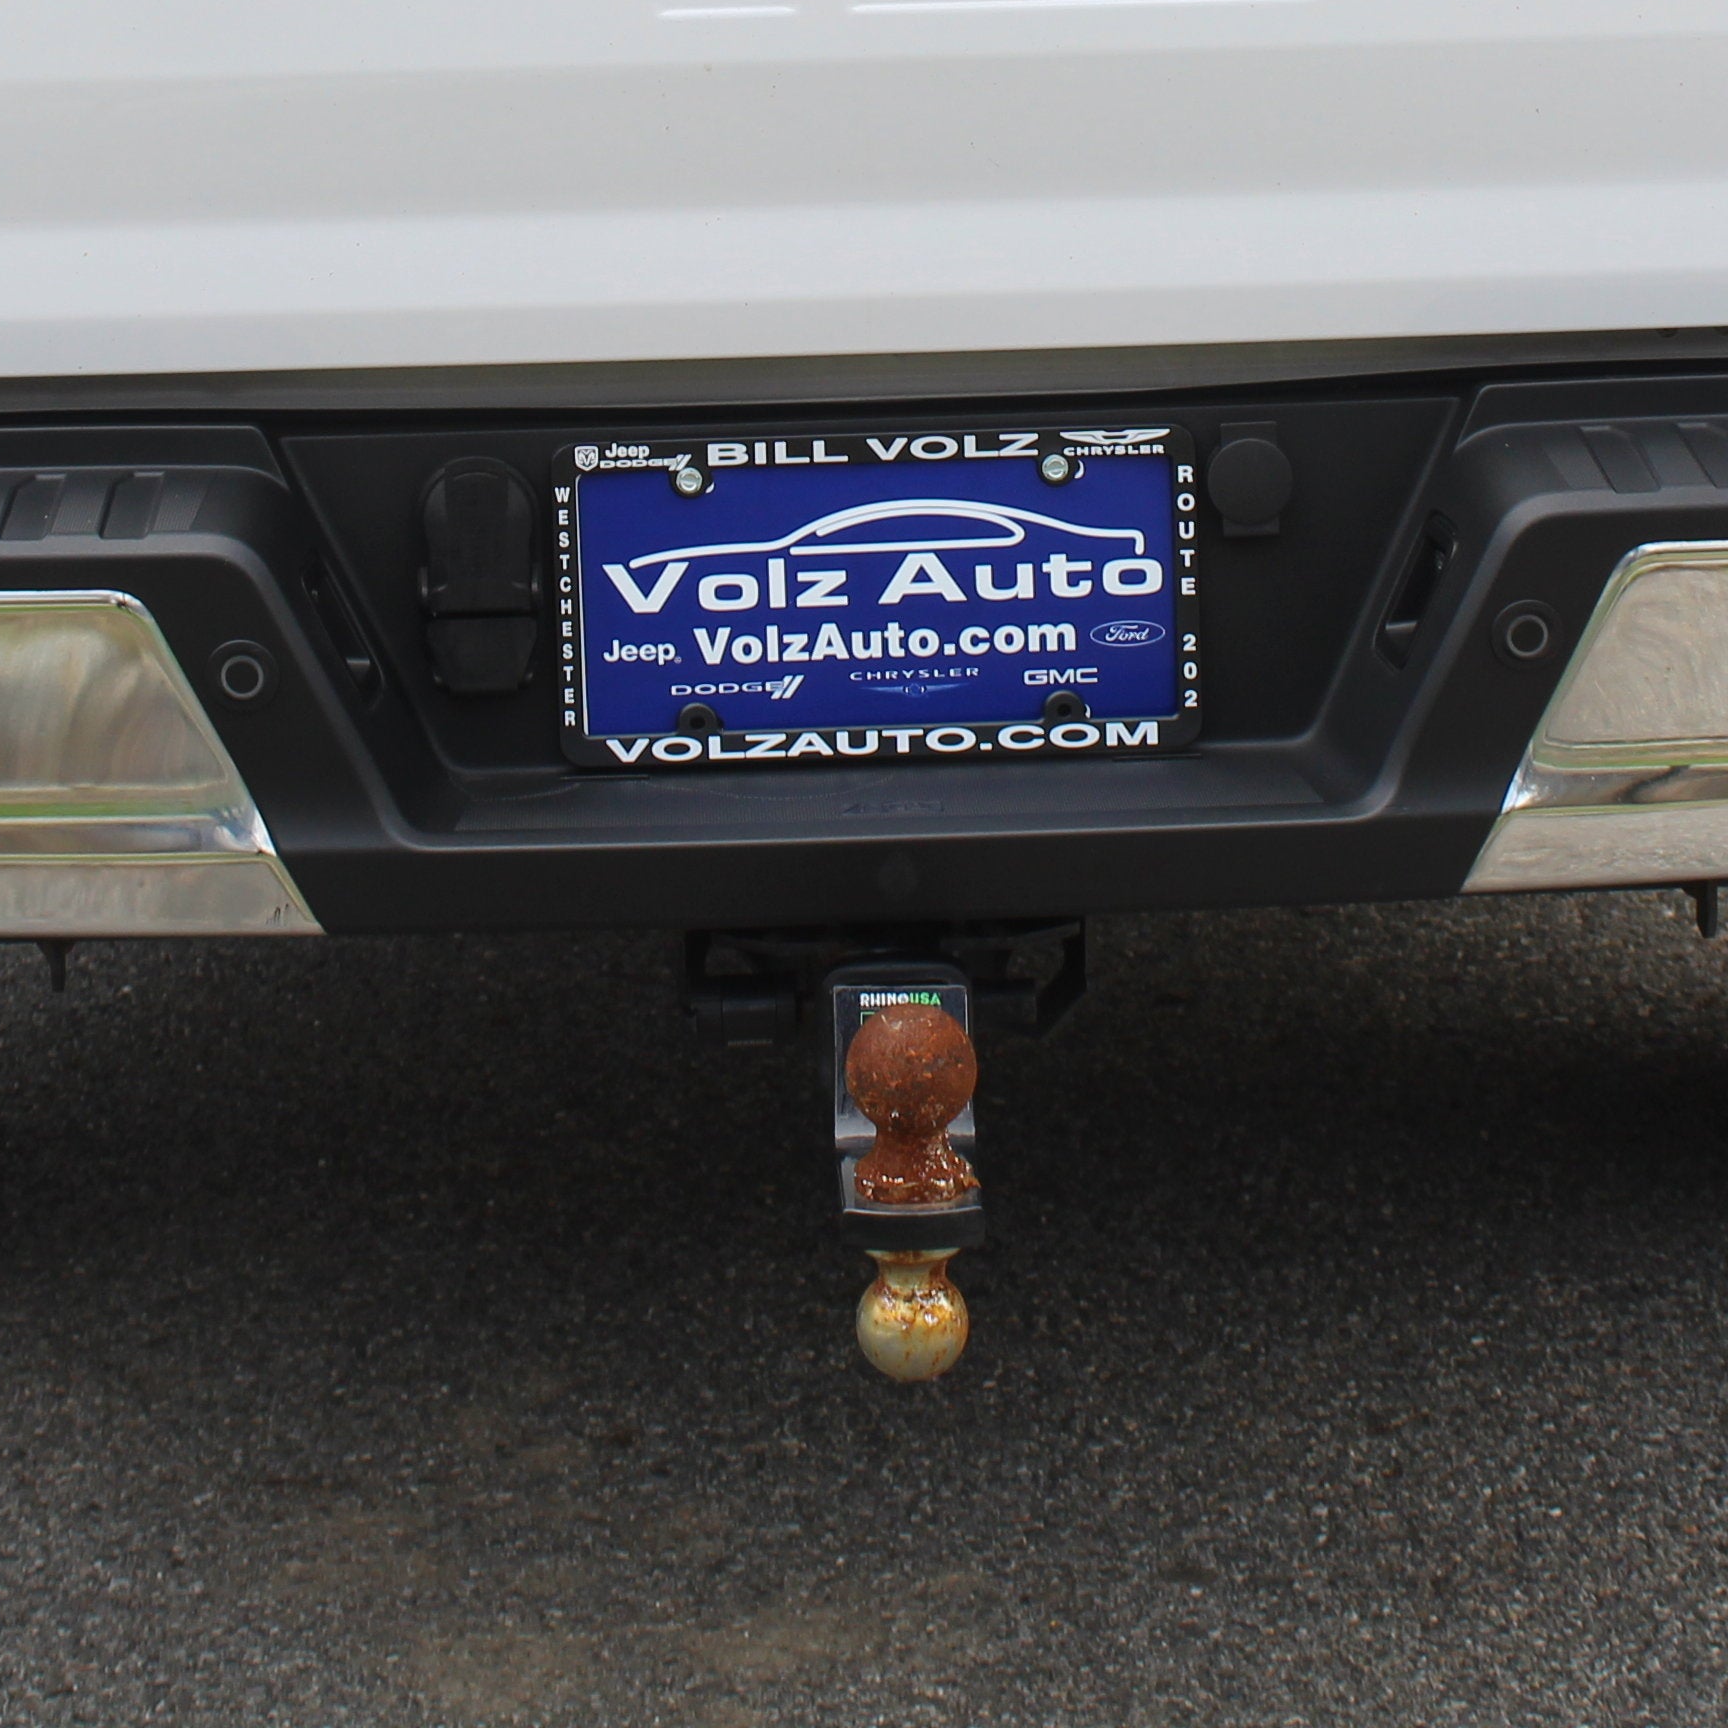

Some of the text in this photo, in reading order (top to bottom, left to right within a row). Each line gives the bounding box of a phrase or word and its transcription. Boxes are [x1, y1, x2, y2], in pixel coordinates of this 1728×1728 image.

[604, 442, 650, 460] Jeep
[706, 432, 1039, 467] BILL VOLZ
[1063, 444, 1165, 457] CHRYSLER
[599, 457, 678, 469] DODGE
[601, 552, 1164, 614] Volz Auto
[1176, 464, 1199, 708] ROUTE 202
[554, 486, 576, 728] WESTCHESTER
[692, 621, 1077, 666] VolzAuto.com
[1104, 624, 1150, 642] Ford
[603, 639, 677, 666] Jeep
[849, 667, 980, 681] CHRYSLER
[1023, 667, 1099, 686] GMC
[670, 679, 788, 697] DODGE
[604, 721, 1160, 764] VOLZAUTO.COM
